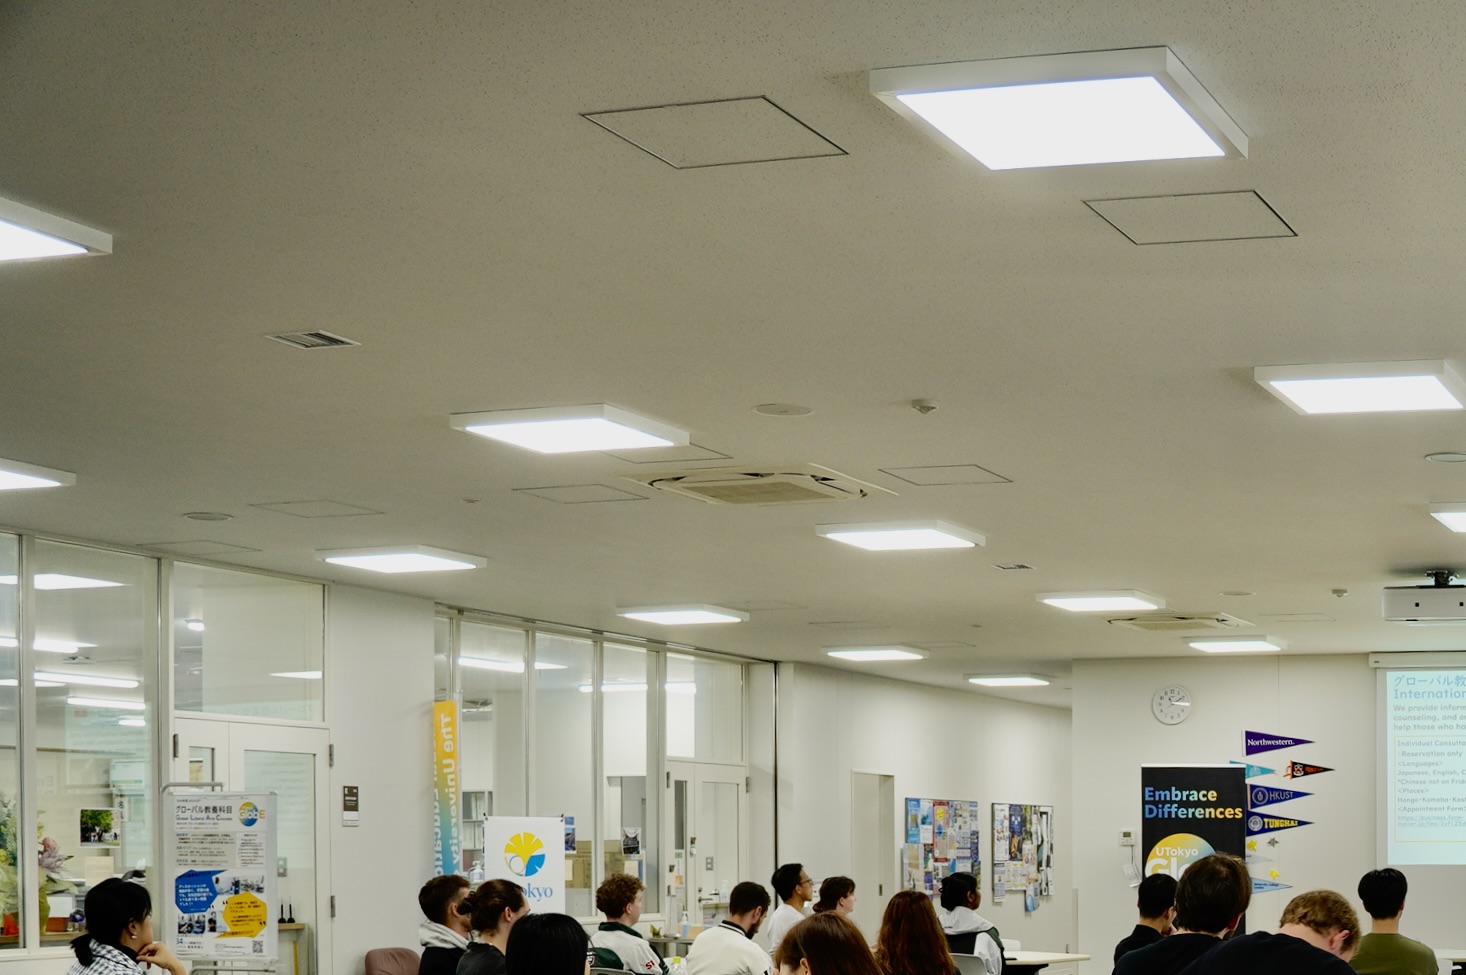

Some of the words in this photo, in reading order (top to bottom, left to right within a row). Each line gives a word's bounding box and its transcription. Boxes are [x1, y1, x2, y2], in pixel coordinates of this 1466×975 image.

[1408, 705, 1438, 713] provide
[1393, 714, 1439, 722] counseling,
[1433, 769, 1459, 777] English,
[1145, 787, 1217, 801] Embrace
[1270, 792, 1293, 800] HKUST
[1145, 804, 1242, 818] Differences
[1156, 847, 1198, 858] UTokyo
